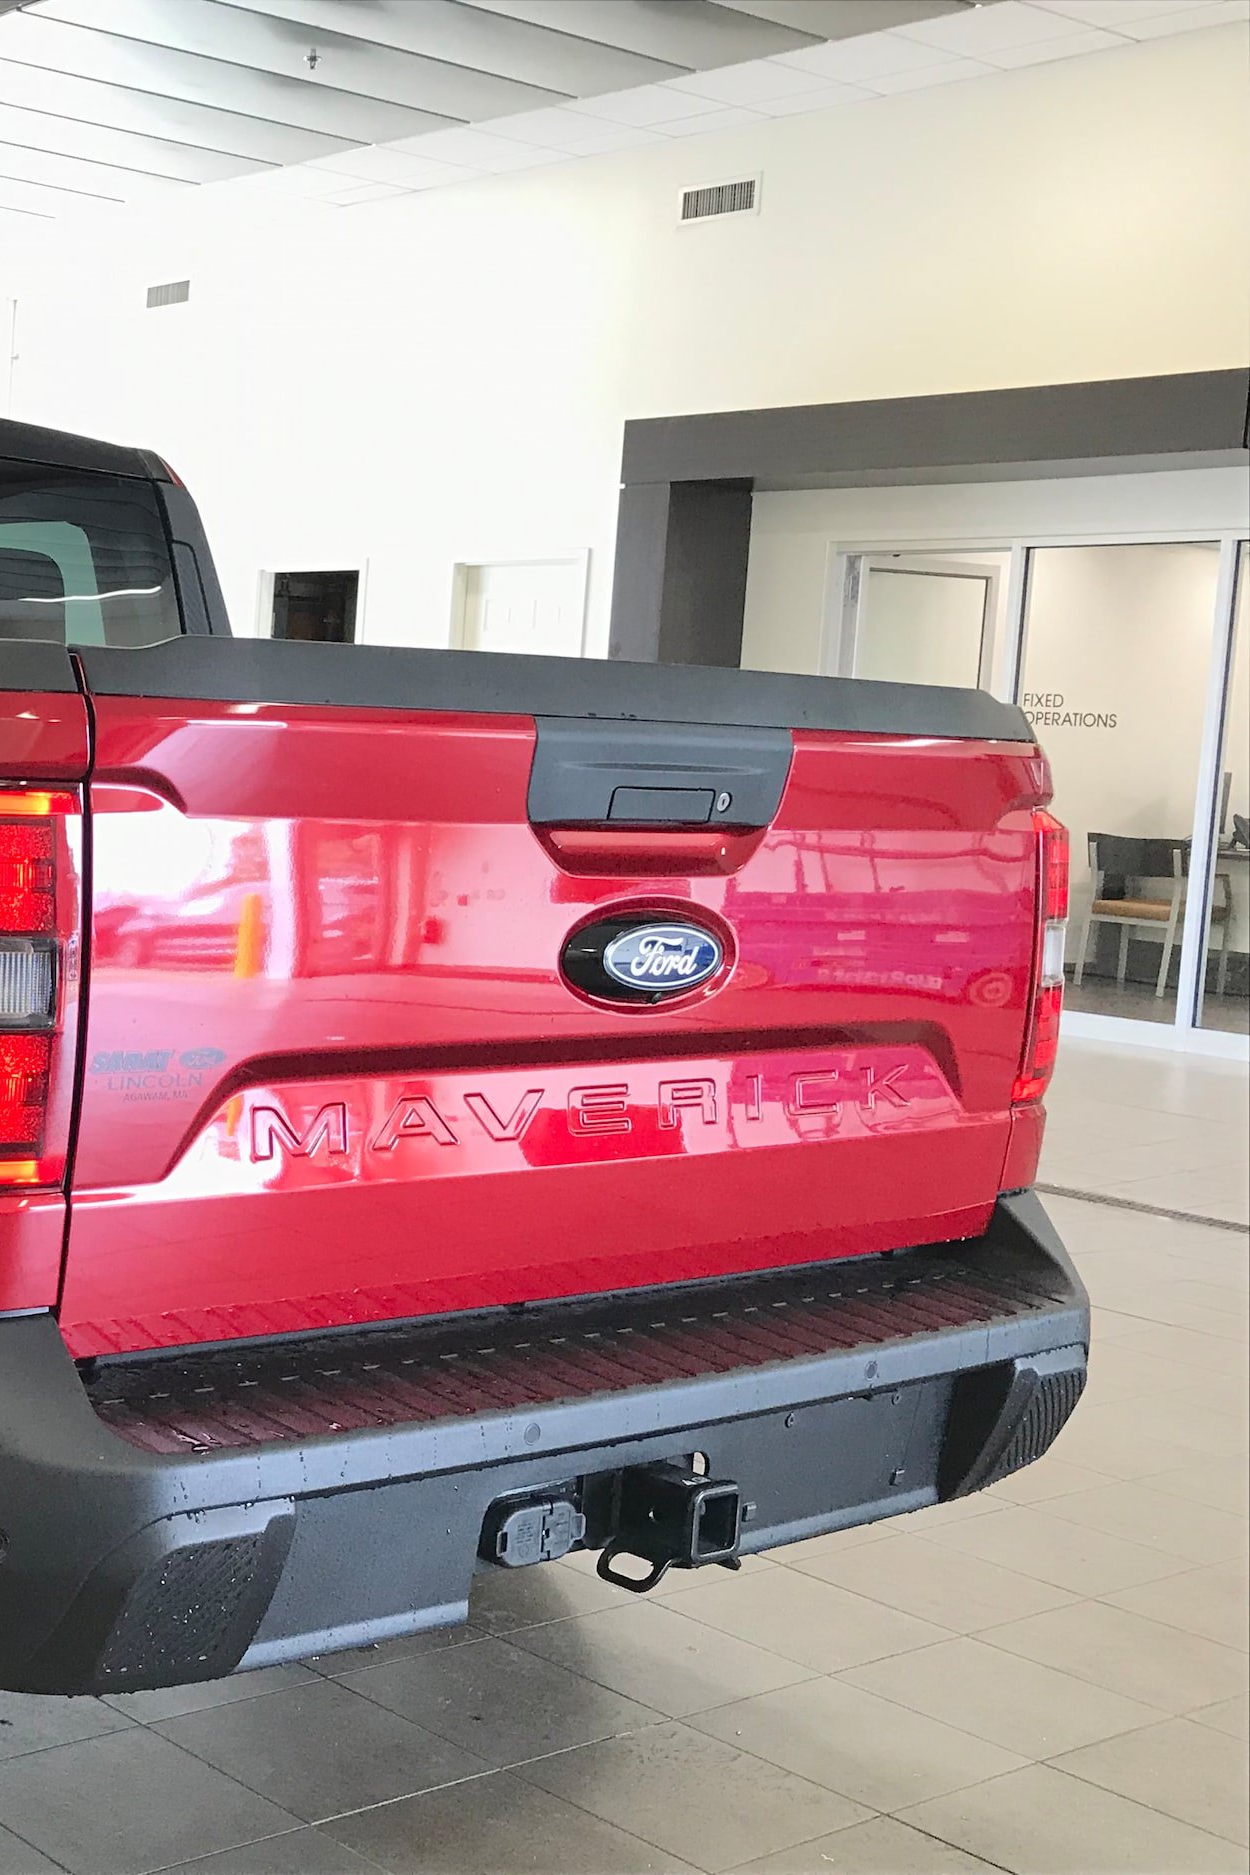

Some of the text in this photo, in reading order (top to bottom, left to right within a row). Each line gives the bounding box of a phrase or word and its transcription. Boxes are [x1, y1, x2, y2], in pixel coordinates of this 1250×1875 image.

[1023, 693, 1064, 708] FIXED
[1023, 711, 1118, 728] OPERATIONS
[630, 935, 699, 977] Ford
[107, 1073, 204, 1092] LINCOLN
[249, 1062, 911, 1163] MAVERICK
